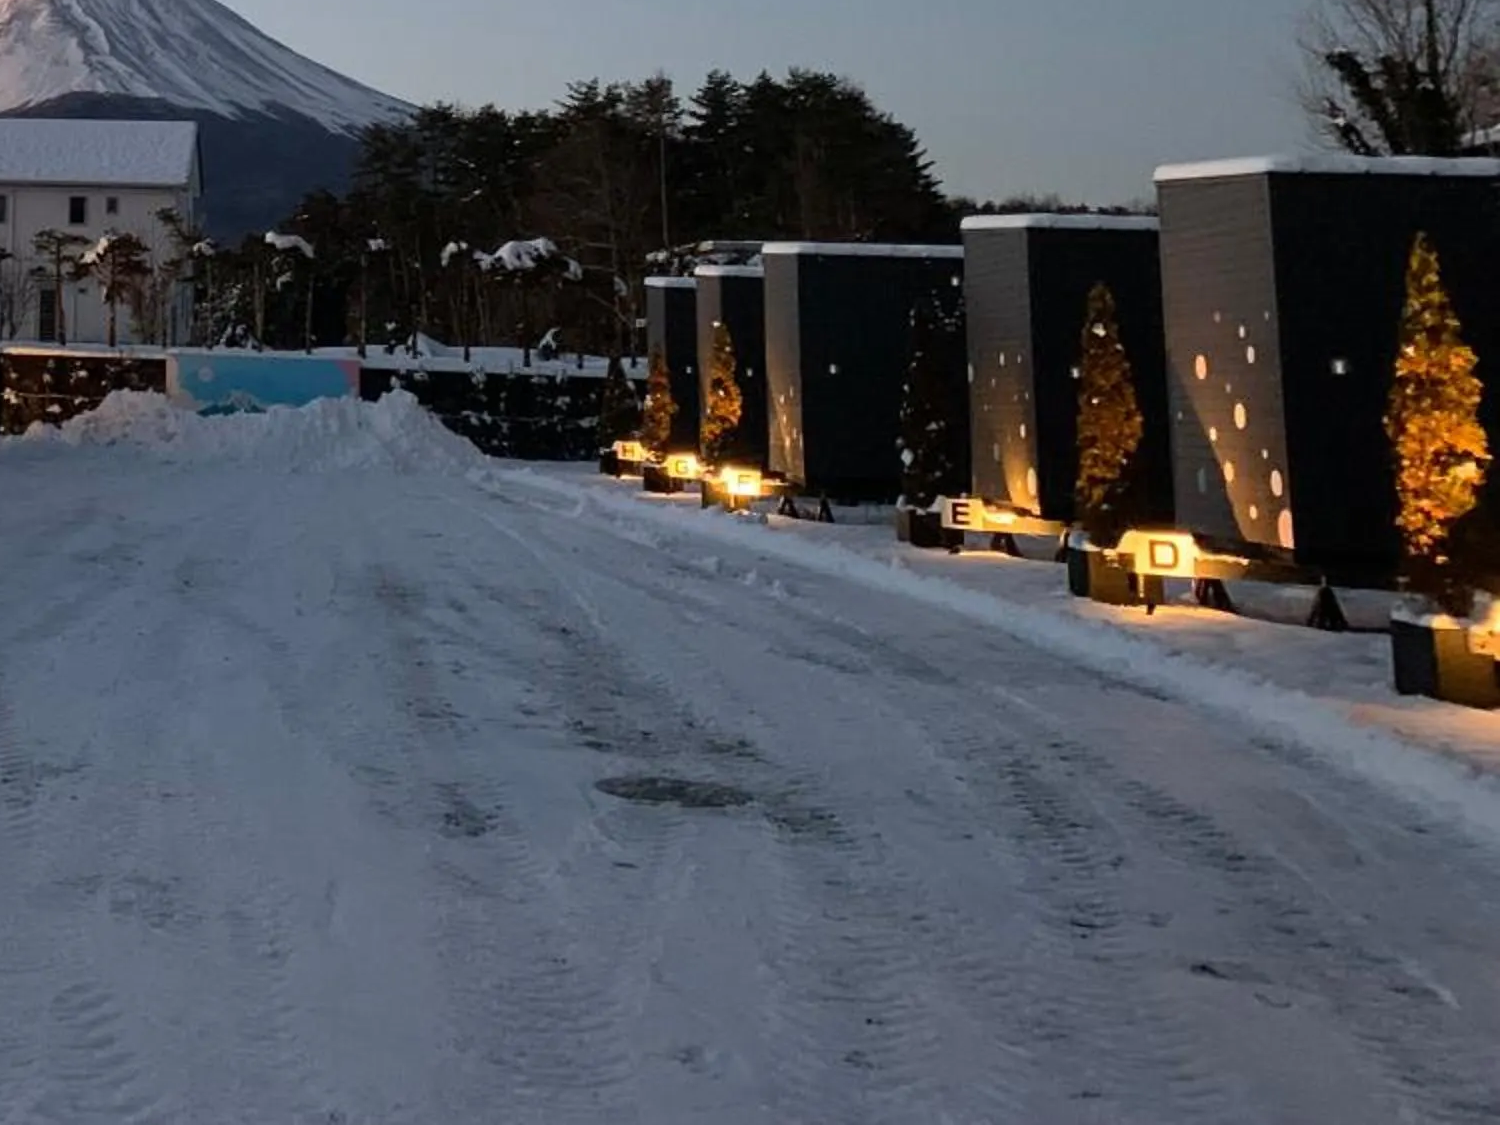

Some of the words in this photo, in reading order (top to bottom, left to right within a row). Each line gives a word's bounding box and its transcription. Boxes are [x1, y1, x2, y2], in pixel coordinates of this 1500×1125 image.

[621, 444, 635, 458] H
[952, 502, 970, 525] E
[1149, 539, 1179, 570] D
